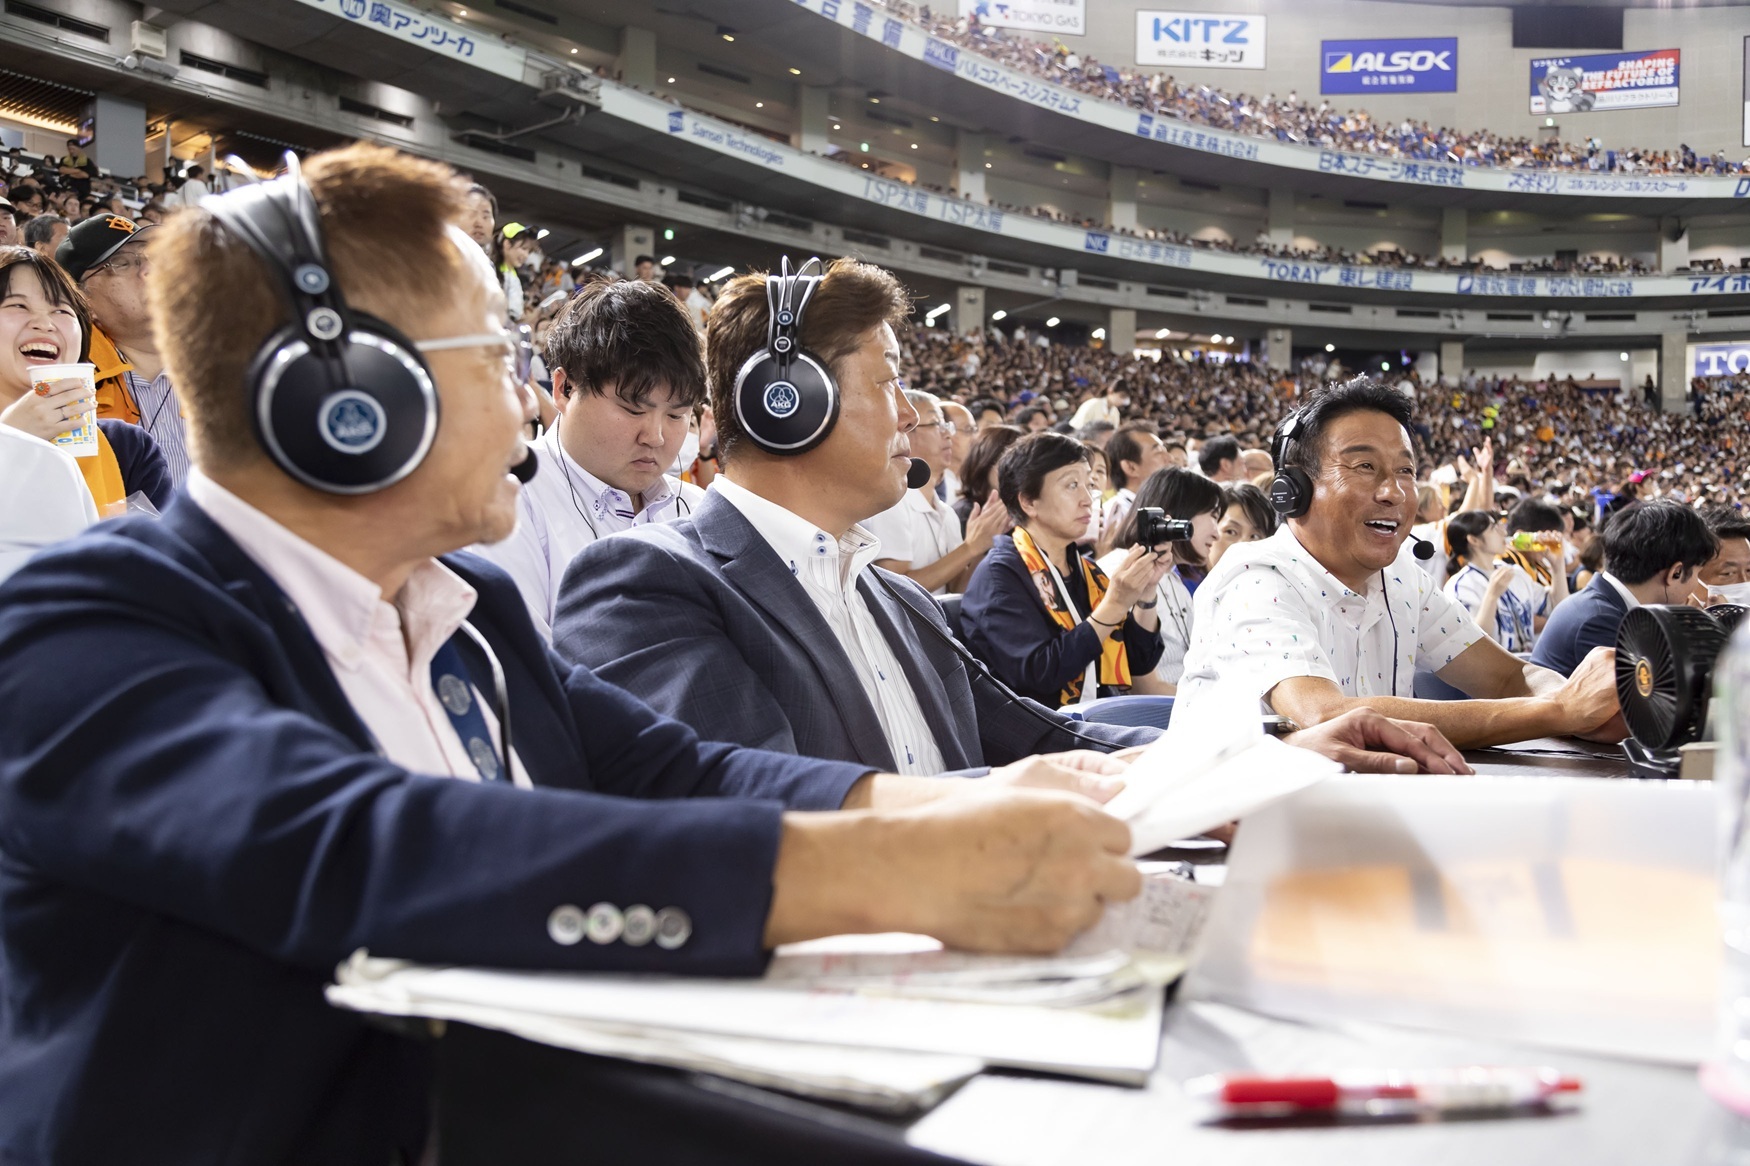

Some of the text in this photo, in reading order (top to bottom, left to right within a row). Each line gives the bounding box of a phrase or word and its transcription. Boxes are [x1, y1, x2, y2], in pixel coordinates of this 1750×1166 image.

[369, 3, 475, 56] 奥アンツーカ
[1153, 17, 1249, 44] KITZ
[1352, 50, 1452, 72] ALSOK
[1618, 57, 1675, 71] SHAPING
[1581, 75, 1675, 91] REFRACTORIES
[1582, 67, 1675, 81] THE FUTURE OF
[725, 131, 784, 165] Technologies
[1318, 151, 1465, 186] 日本ステージ株式会社
